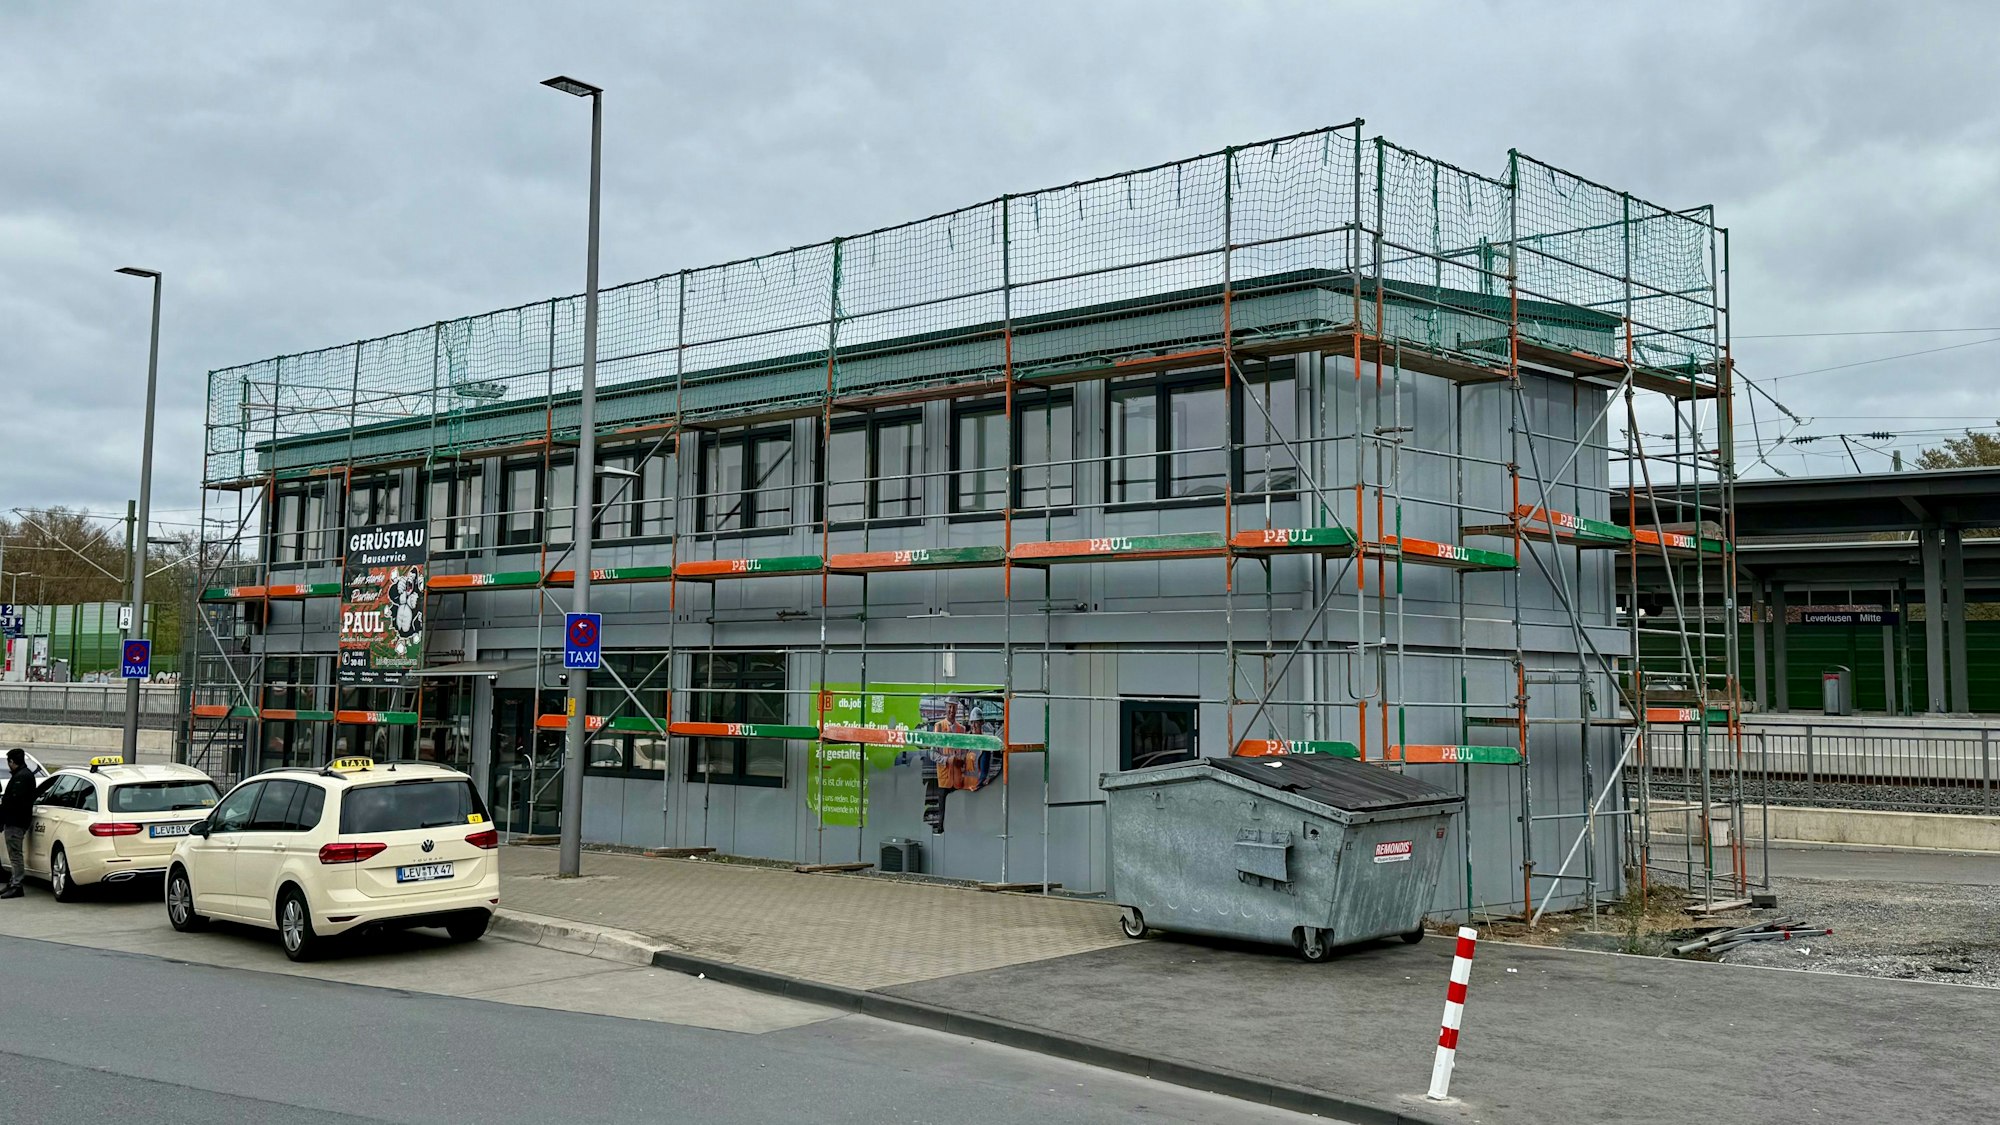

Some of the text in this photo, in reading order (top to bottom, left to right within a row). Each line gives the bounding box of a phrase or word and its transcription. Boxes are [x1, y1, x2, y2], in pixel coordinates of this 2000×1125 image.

[1560, 514, 1587, 531] PAUL
[350, 528, 424, 552] GERÜSTBAU
[1263, 529, 1313, 543] PAUL
[1673, 535, 1697, 549] PAUL
[1089, 537, 1132, 551] PAUL
[894, 549, 930, 562] PAUL
[1437, 544, 1470, 561] PAUL
[361, 553, 407, 565] Bauservice
[731, 559, 762, 571] PAUL
[472, 574, 495, 585] PAUL
[593, 569, 619, 580] PAUL
[224, 588, 240, 597] PAUL
[295, 583, 313, 594] PAUL
[351, 588, 382, 603] Partner!
[6, 605, 12, 614] 2
[342, 612, 384, 632] PAUL
[1805, 614, 1881, 622] Leverkusen Mitte
[568, 651, 597, 663] TAXI
[125, 666, 147, 674] TAXI
[838, 698, 866, 710] db.job
[367, 712, 387, 722] PAUL
[1680, 709, 1700, 720] PAUL
[728, 724, 757, 736] PAUL
[888, 730, 922, 745] PAUL
[1266, 740, 1316, 755] PAUL
[1442, 747, 1474, 760] PAUL
[344, 759, 368, 767] TAXI
[155, 826, 170, 835] LEV
[1376, 842, 1410, 856] REMONDIS
[403, 865, 452, 878] LEV TX 47
